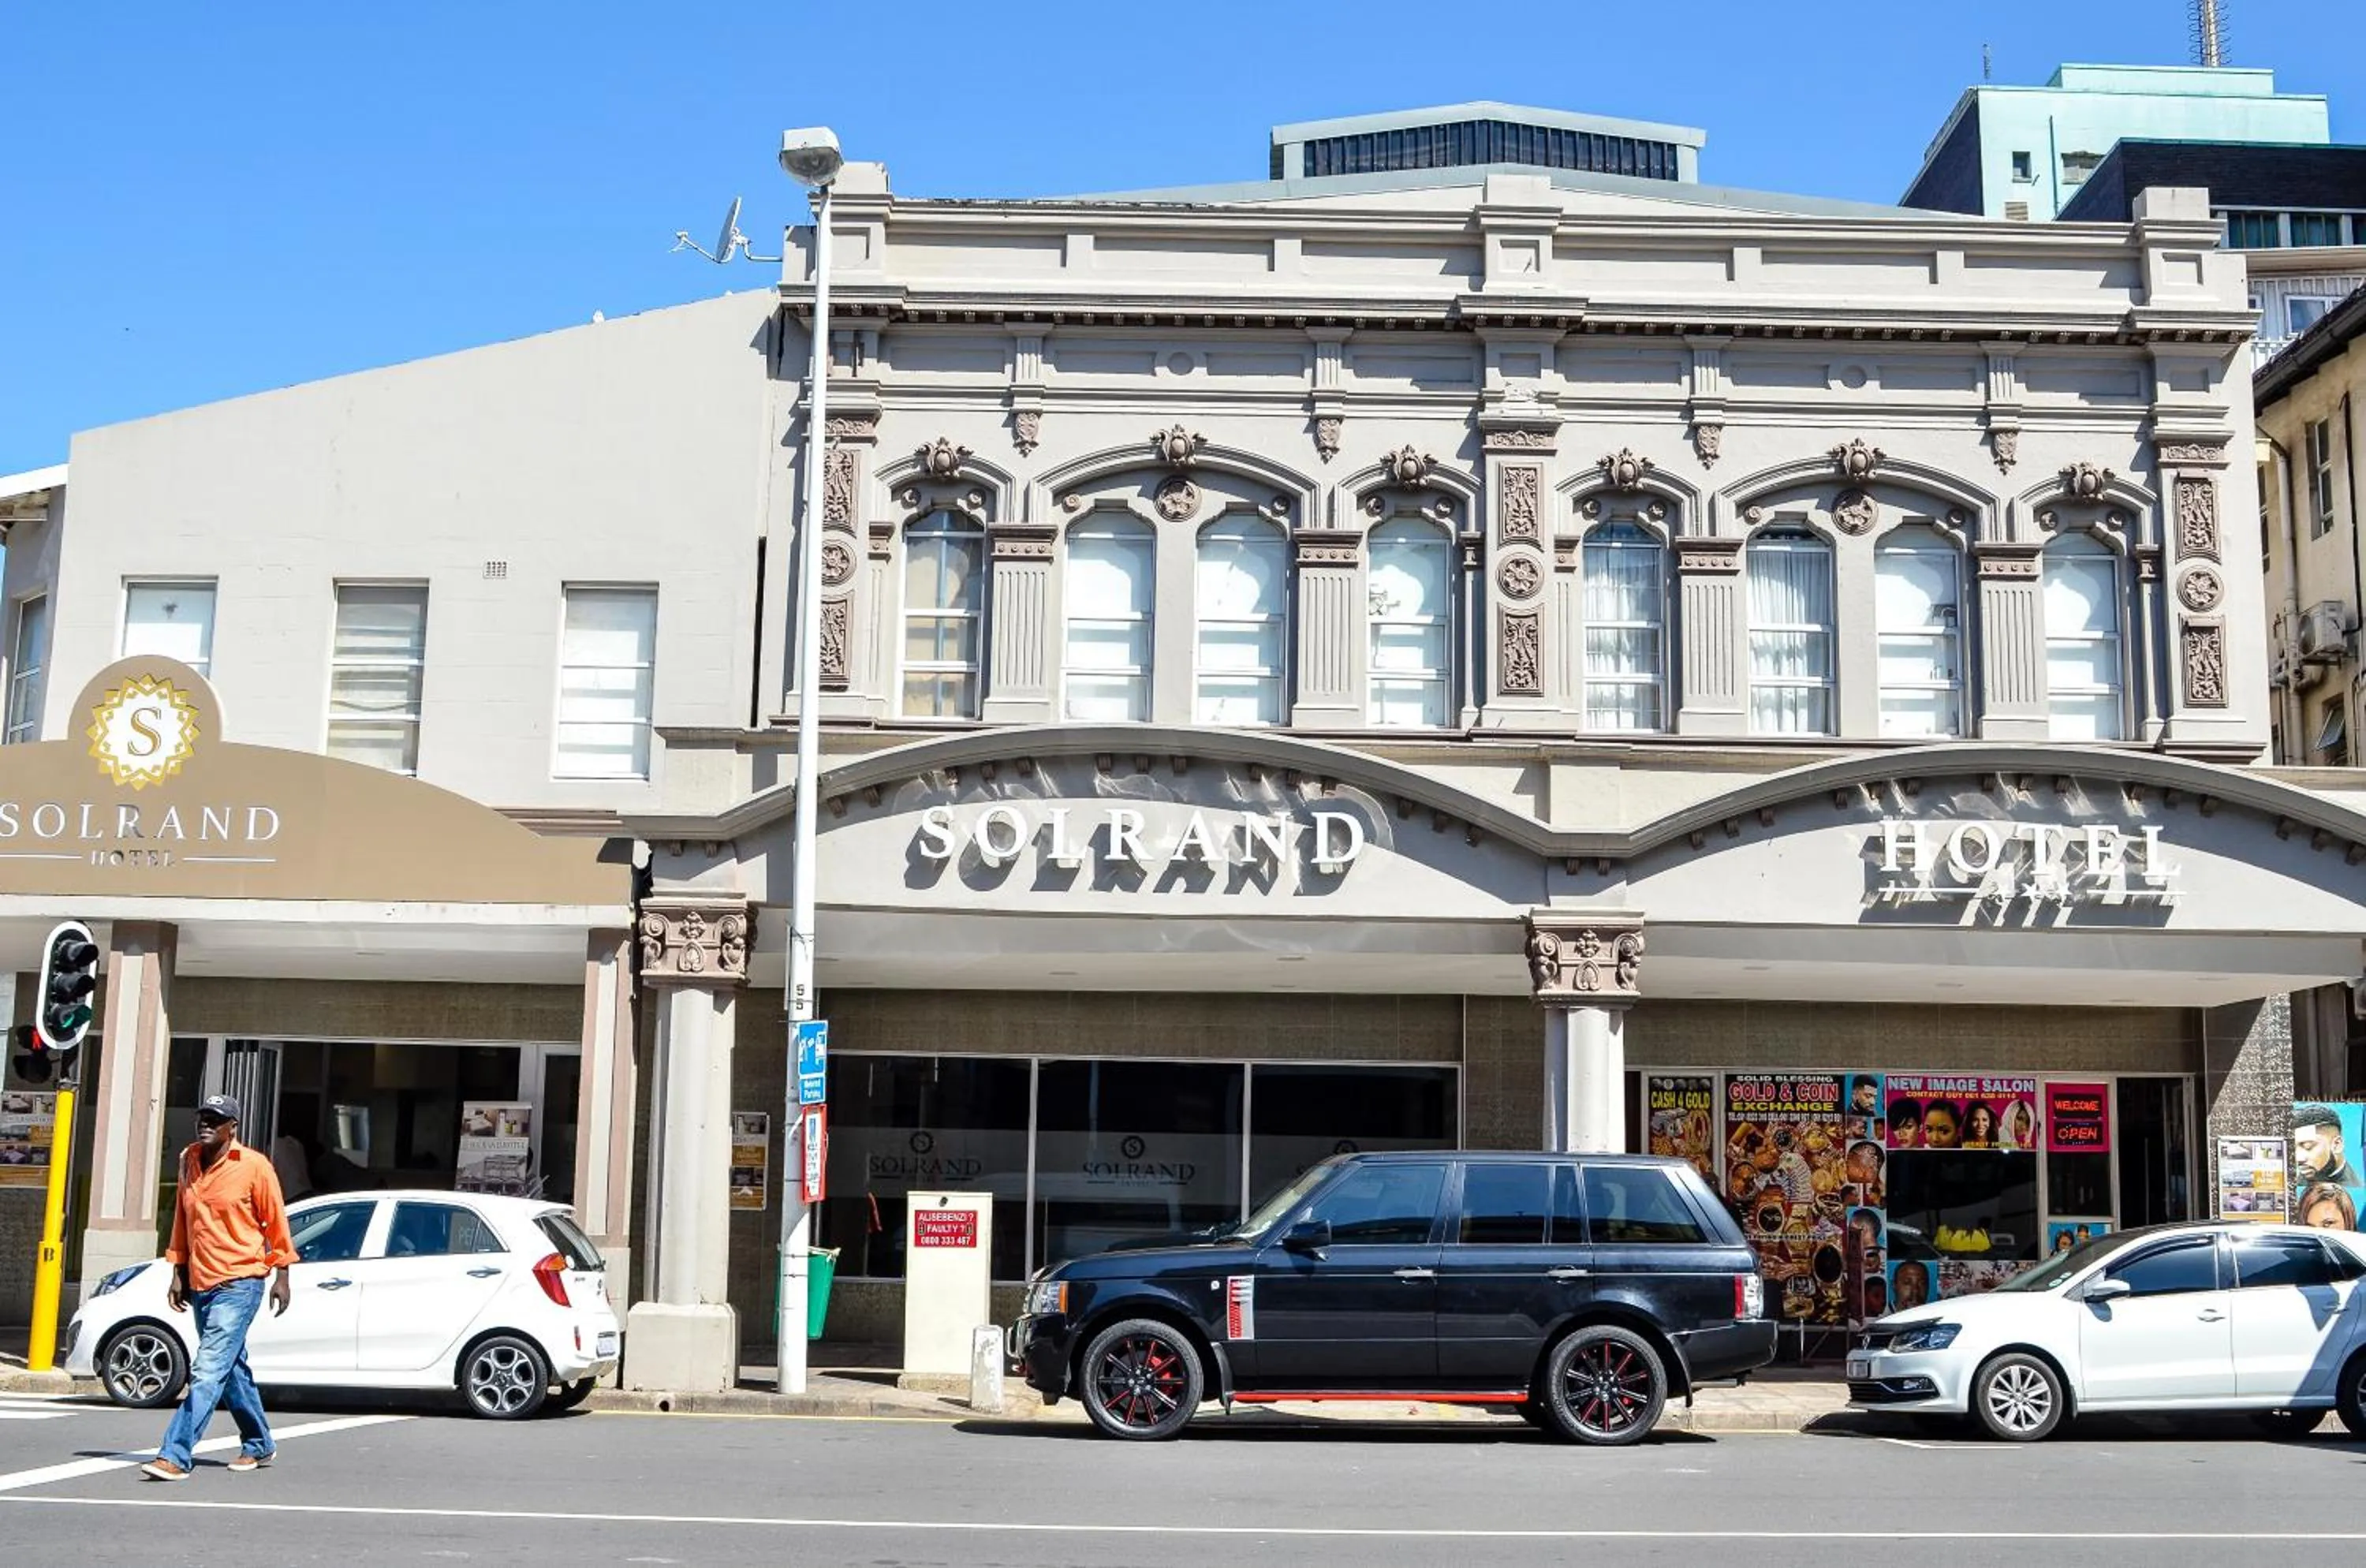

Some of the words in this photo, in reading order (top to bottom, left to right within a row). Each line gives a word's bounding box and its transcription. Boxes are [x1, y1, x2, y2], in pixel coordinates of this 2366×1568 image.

[128, 707, 162, 756] S
[0, 802, 281, 841] SOLRAND
[919, 805, 1365, 864] SOLRAND
[1878, 818, 2181, 876] HOTEL
[91, 849, 177, 867] HOTEL
[1729, 1082, 1775, 1101] GOLD
[1779, 1082, 1793, 1101] &
[1797, 1083, 1839, 1102] COIN
[1887, 1077, 1923, 1091] NEW
[1928, 1078, 1978, 1092] IMAGE
[1982, 1078, 2035, 1092] SALON
[1651, 1092, 1676, 1108] CASH
[1677, 1092, 1684, 1107] 4
[1685, 1092, 1711, 1109] GOLD
[1731, 1103, 1835, 1111] EXCHANGE
[2054, 1100, 2100, 1111] WELCOME
[2058, 1127, 2098, 1140] OPEN
[869, 1155, 982, 1176] SOLRAND
[1083, 1161, 1196, 1181] SOLRAND
[927, 1223, 959, 1233] FAULTY
